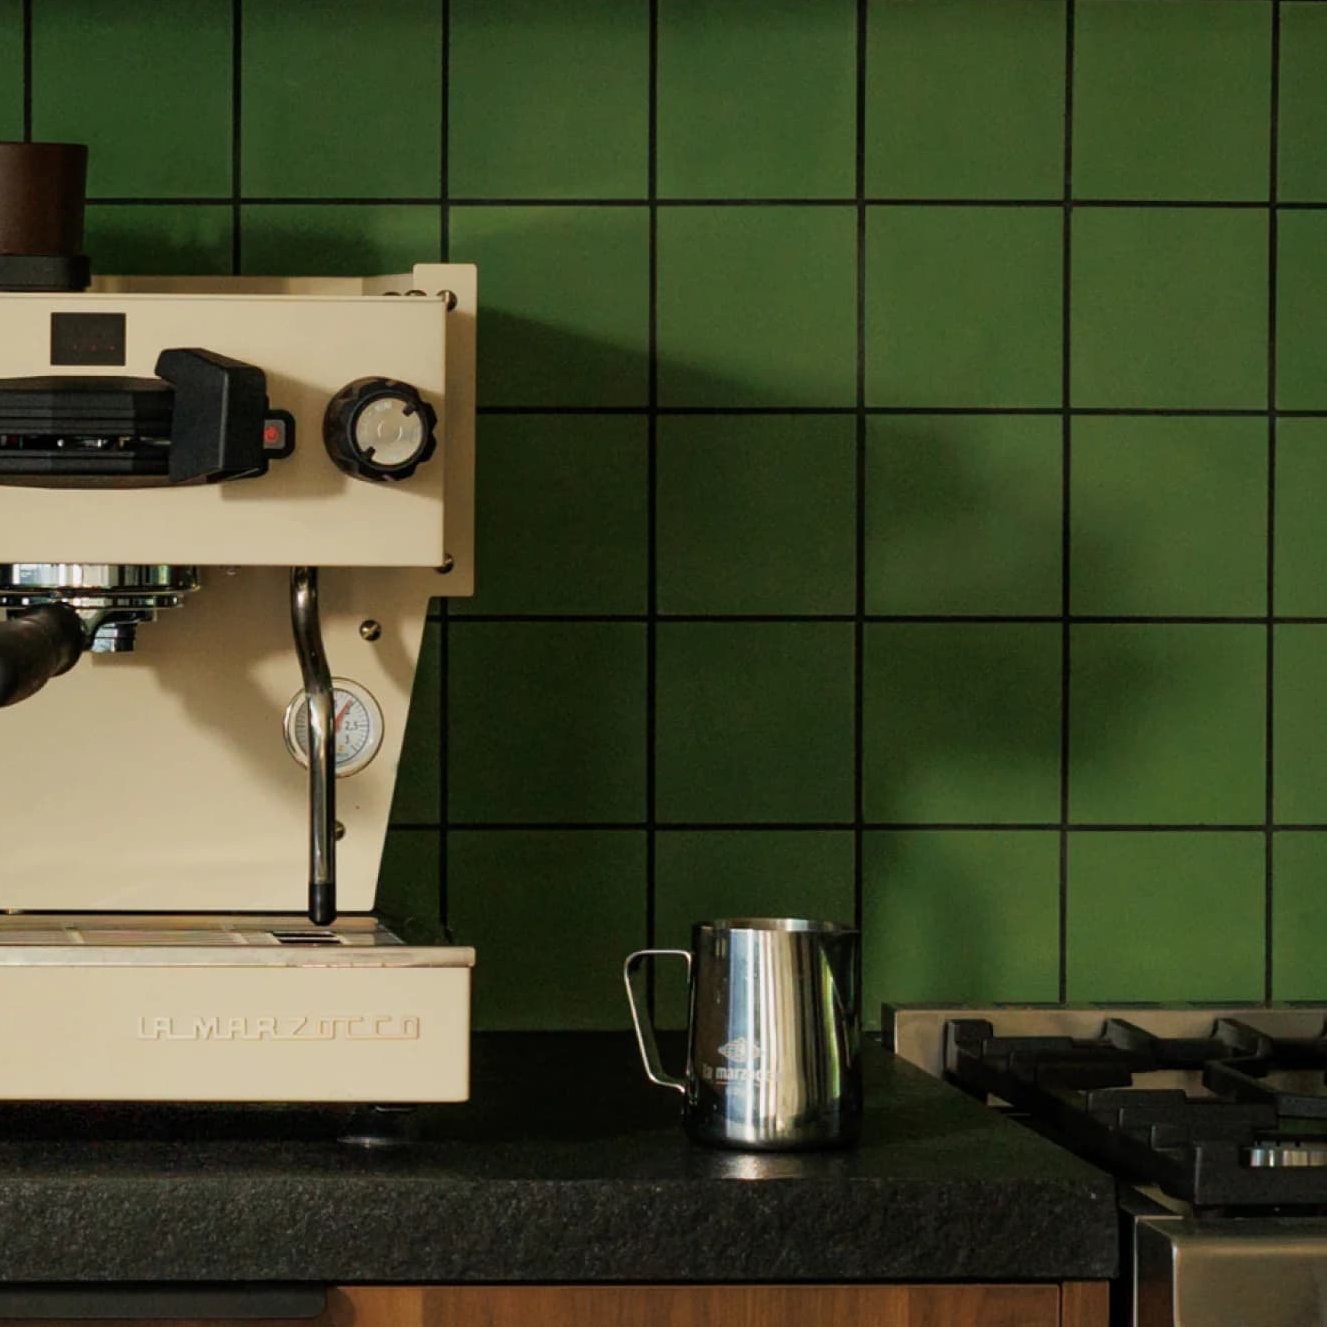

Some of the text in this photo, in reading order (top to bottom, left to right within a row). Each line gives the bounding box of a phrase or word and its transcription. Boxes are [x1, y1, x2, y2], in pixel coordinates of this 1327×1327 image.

[136, 1016, 421, 1041] LA MARZOCCO
[715, 1067, 775, 1082] marzc
